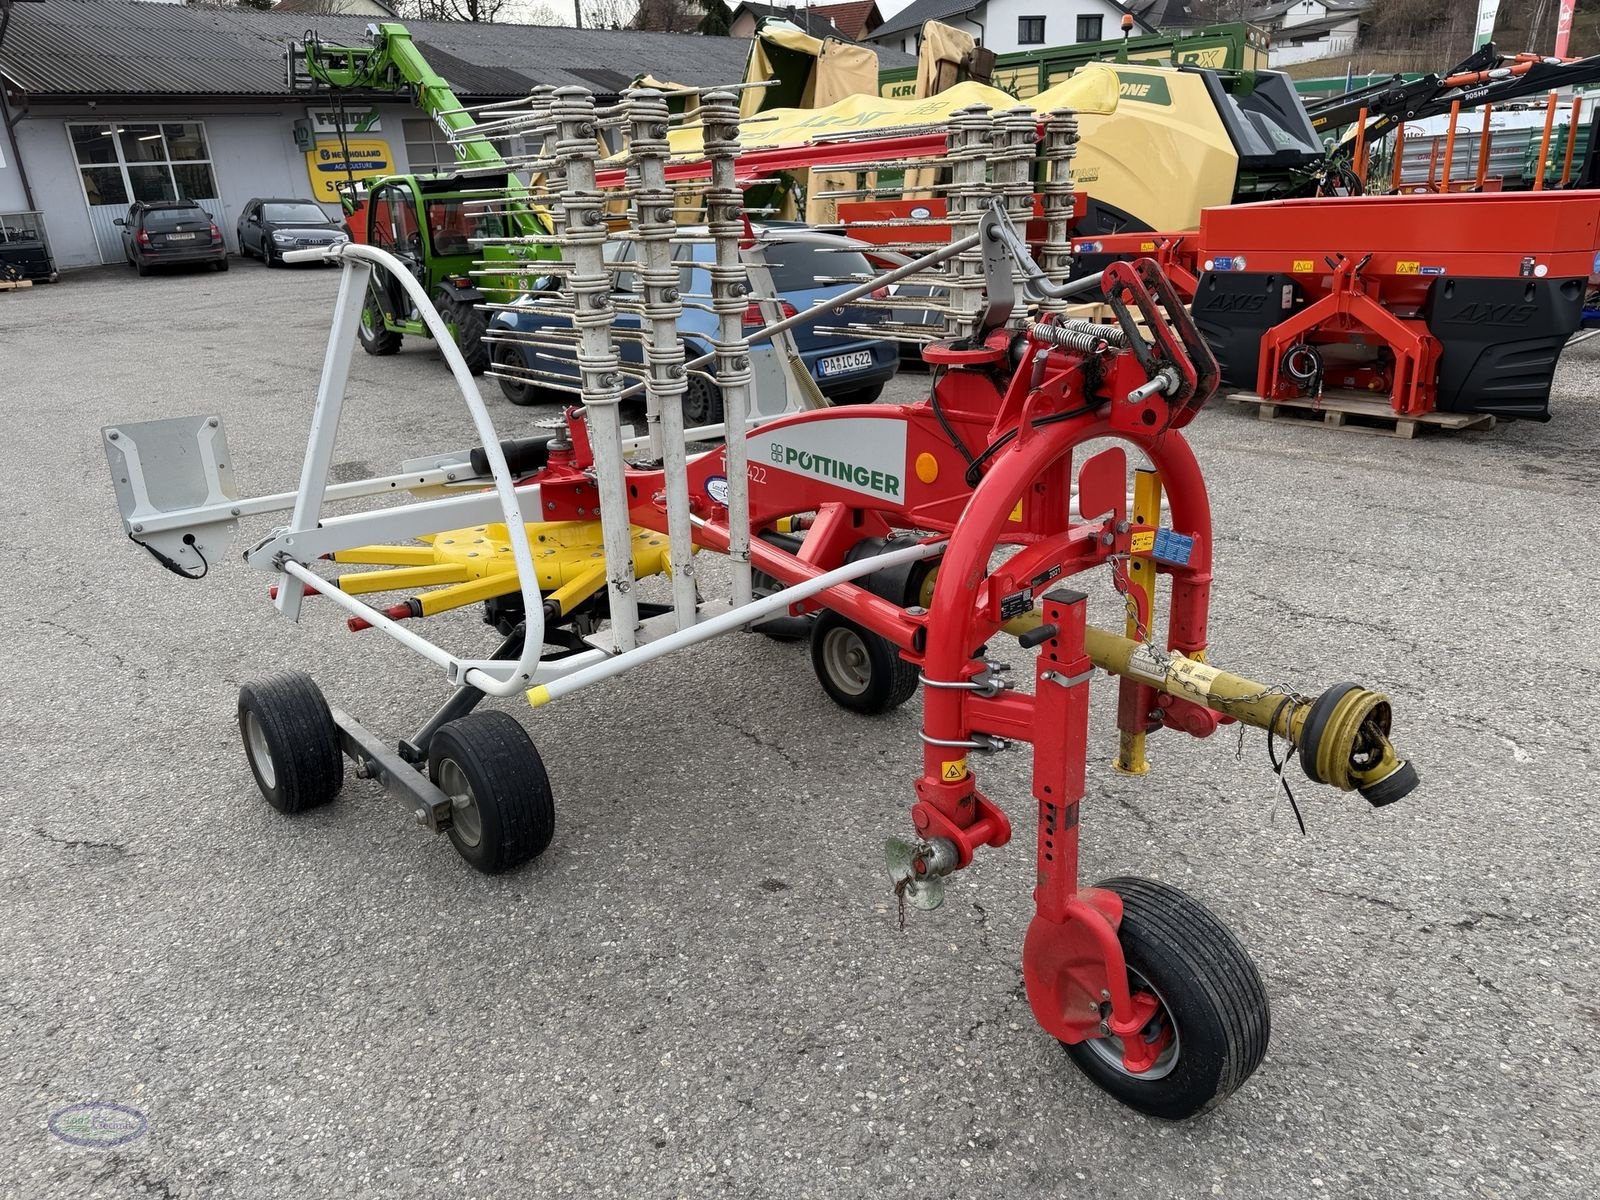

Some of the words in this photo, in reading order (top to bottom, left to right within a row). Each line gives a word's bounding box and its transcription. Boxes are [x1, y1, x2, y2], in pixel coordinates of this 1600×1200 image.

[1465, 88, 1489, 100] 905HP
[823, 359, 837, 372] PA
[842, 355, 853, 369] IC
[854, 352, 870, 366] 622
[785, 447, 900, 496] PÖTTINGER
